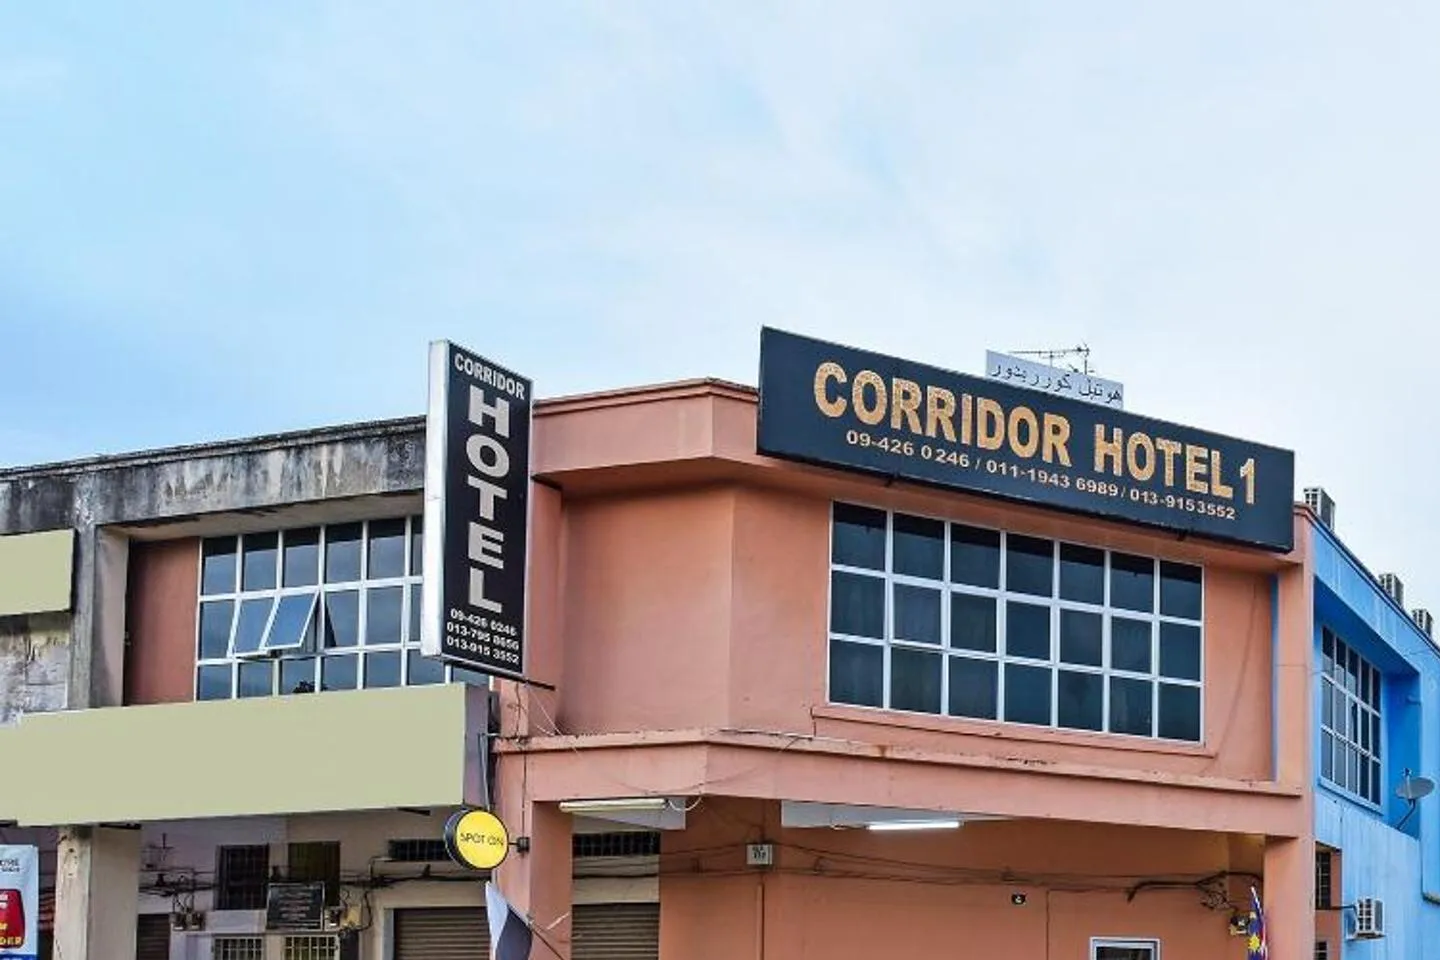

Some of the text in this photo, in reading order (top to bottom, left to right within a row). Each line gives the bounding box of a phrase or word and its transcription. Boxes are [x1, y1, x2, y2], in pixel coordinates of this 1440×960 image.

[454, 352, 525, 401] CORRIDOR
[813, 361, 1256, 505] CORRIDOR HOTEL 1
[846, 429, 915, 457] 09-426
[985, 459, 1071, 490] 011-1943
[1075, 477, 1119, 497] 6989
[1130, 488, 1236, 521] 013-9153552
[466, 385, 510, 613] HOTEL
[460, 832, 486, 844] SPOT
